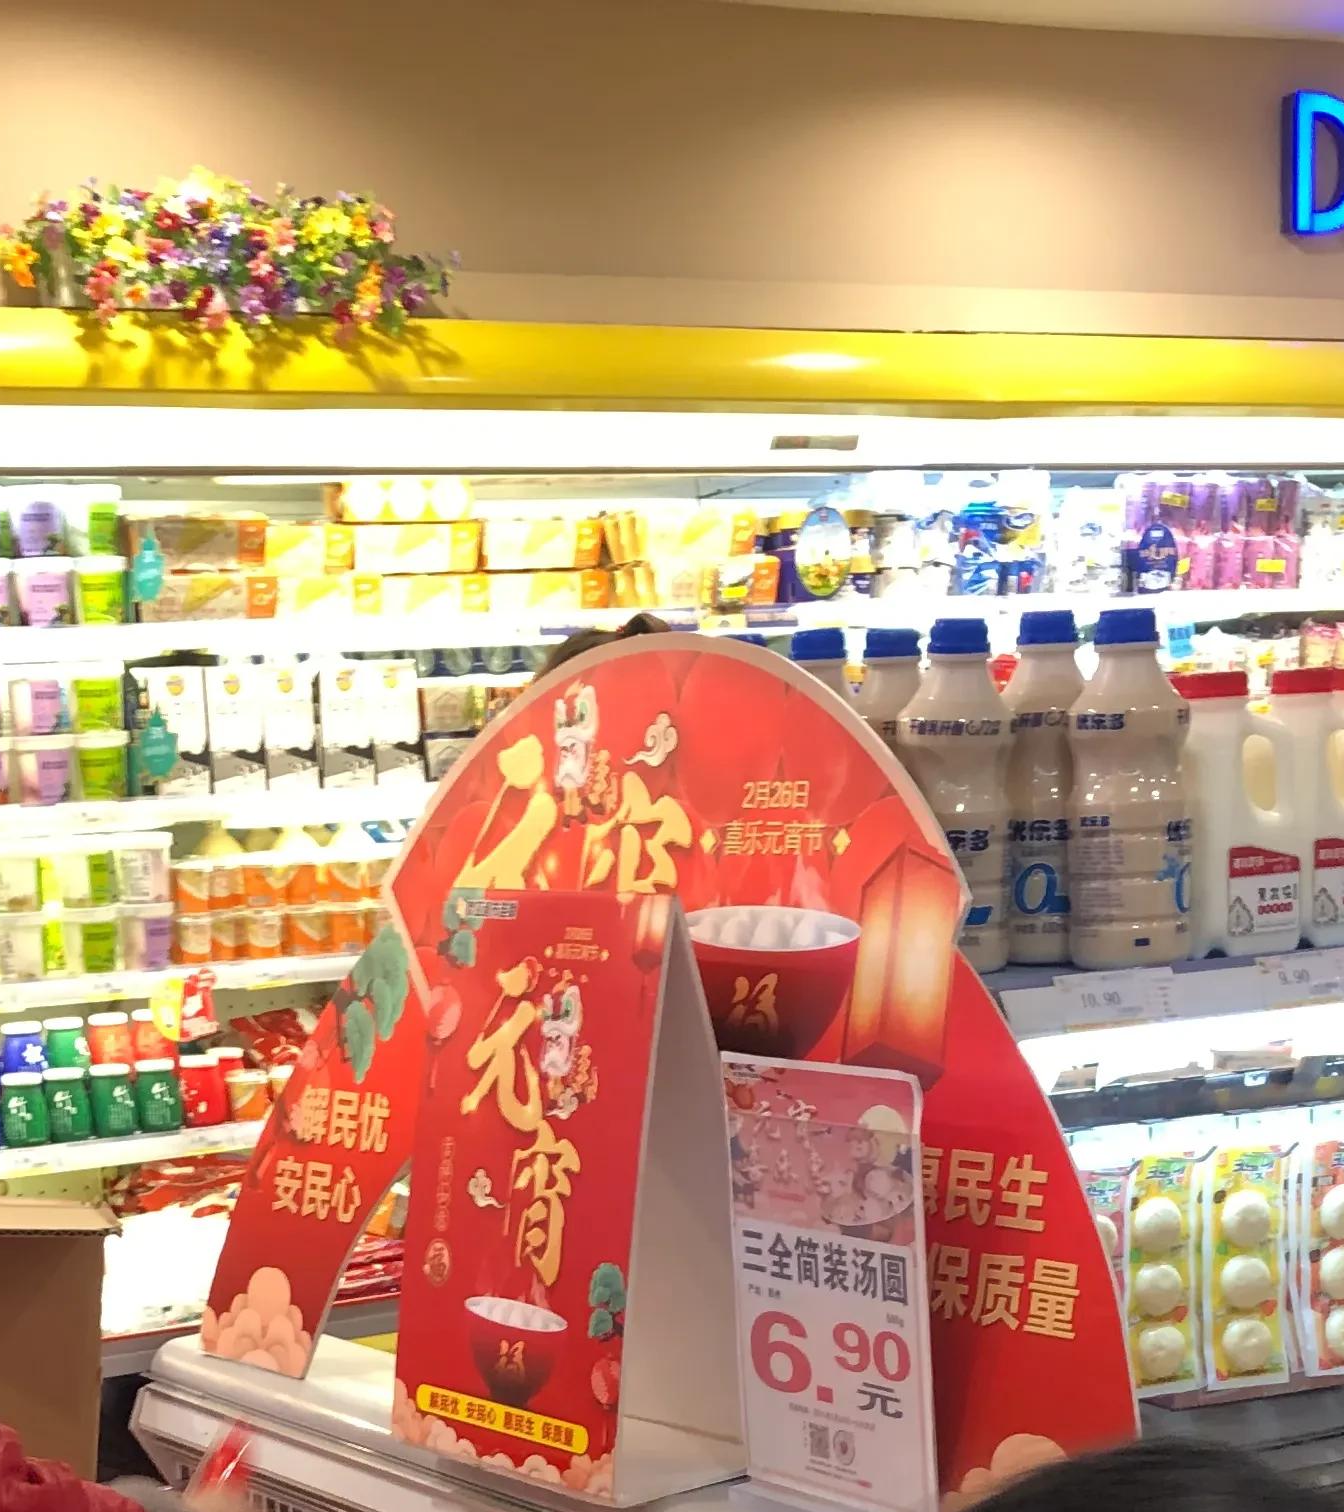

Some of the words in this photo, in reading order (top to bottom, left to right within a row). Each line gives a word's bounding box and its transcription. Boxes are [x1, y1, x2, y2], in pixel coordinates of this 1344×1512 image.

[741, 781, 810, 809] 2月26日
[722, 822, 826, 856] 喜乐元宵节
[298, 1084, 391, 1153] 解民忧
[459, 957, 582, 1287] 元宵
[271, 1156, 362, 1223] 安民心
[742, 1229, 909, 1307] 三全简装汤圆
[927, 1243, 1080, 1340] 保质量
[750, 1310, 911, 1404] 6.90
[429, 1391, 460, 1416] 解民忧
[466, 1401, 496, 1425] 安民心
[856, 1382, 904, 1419] 元
